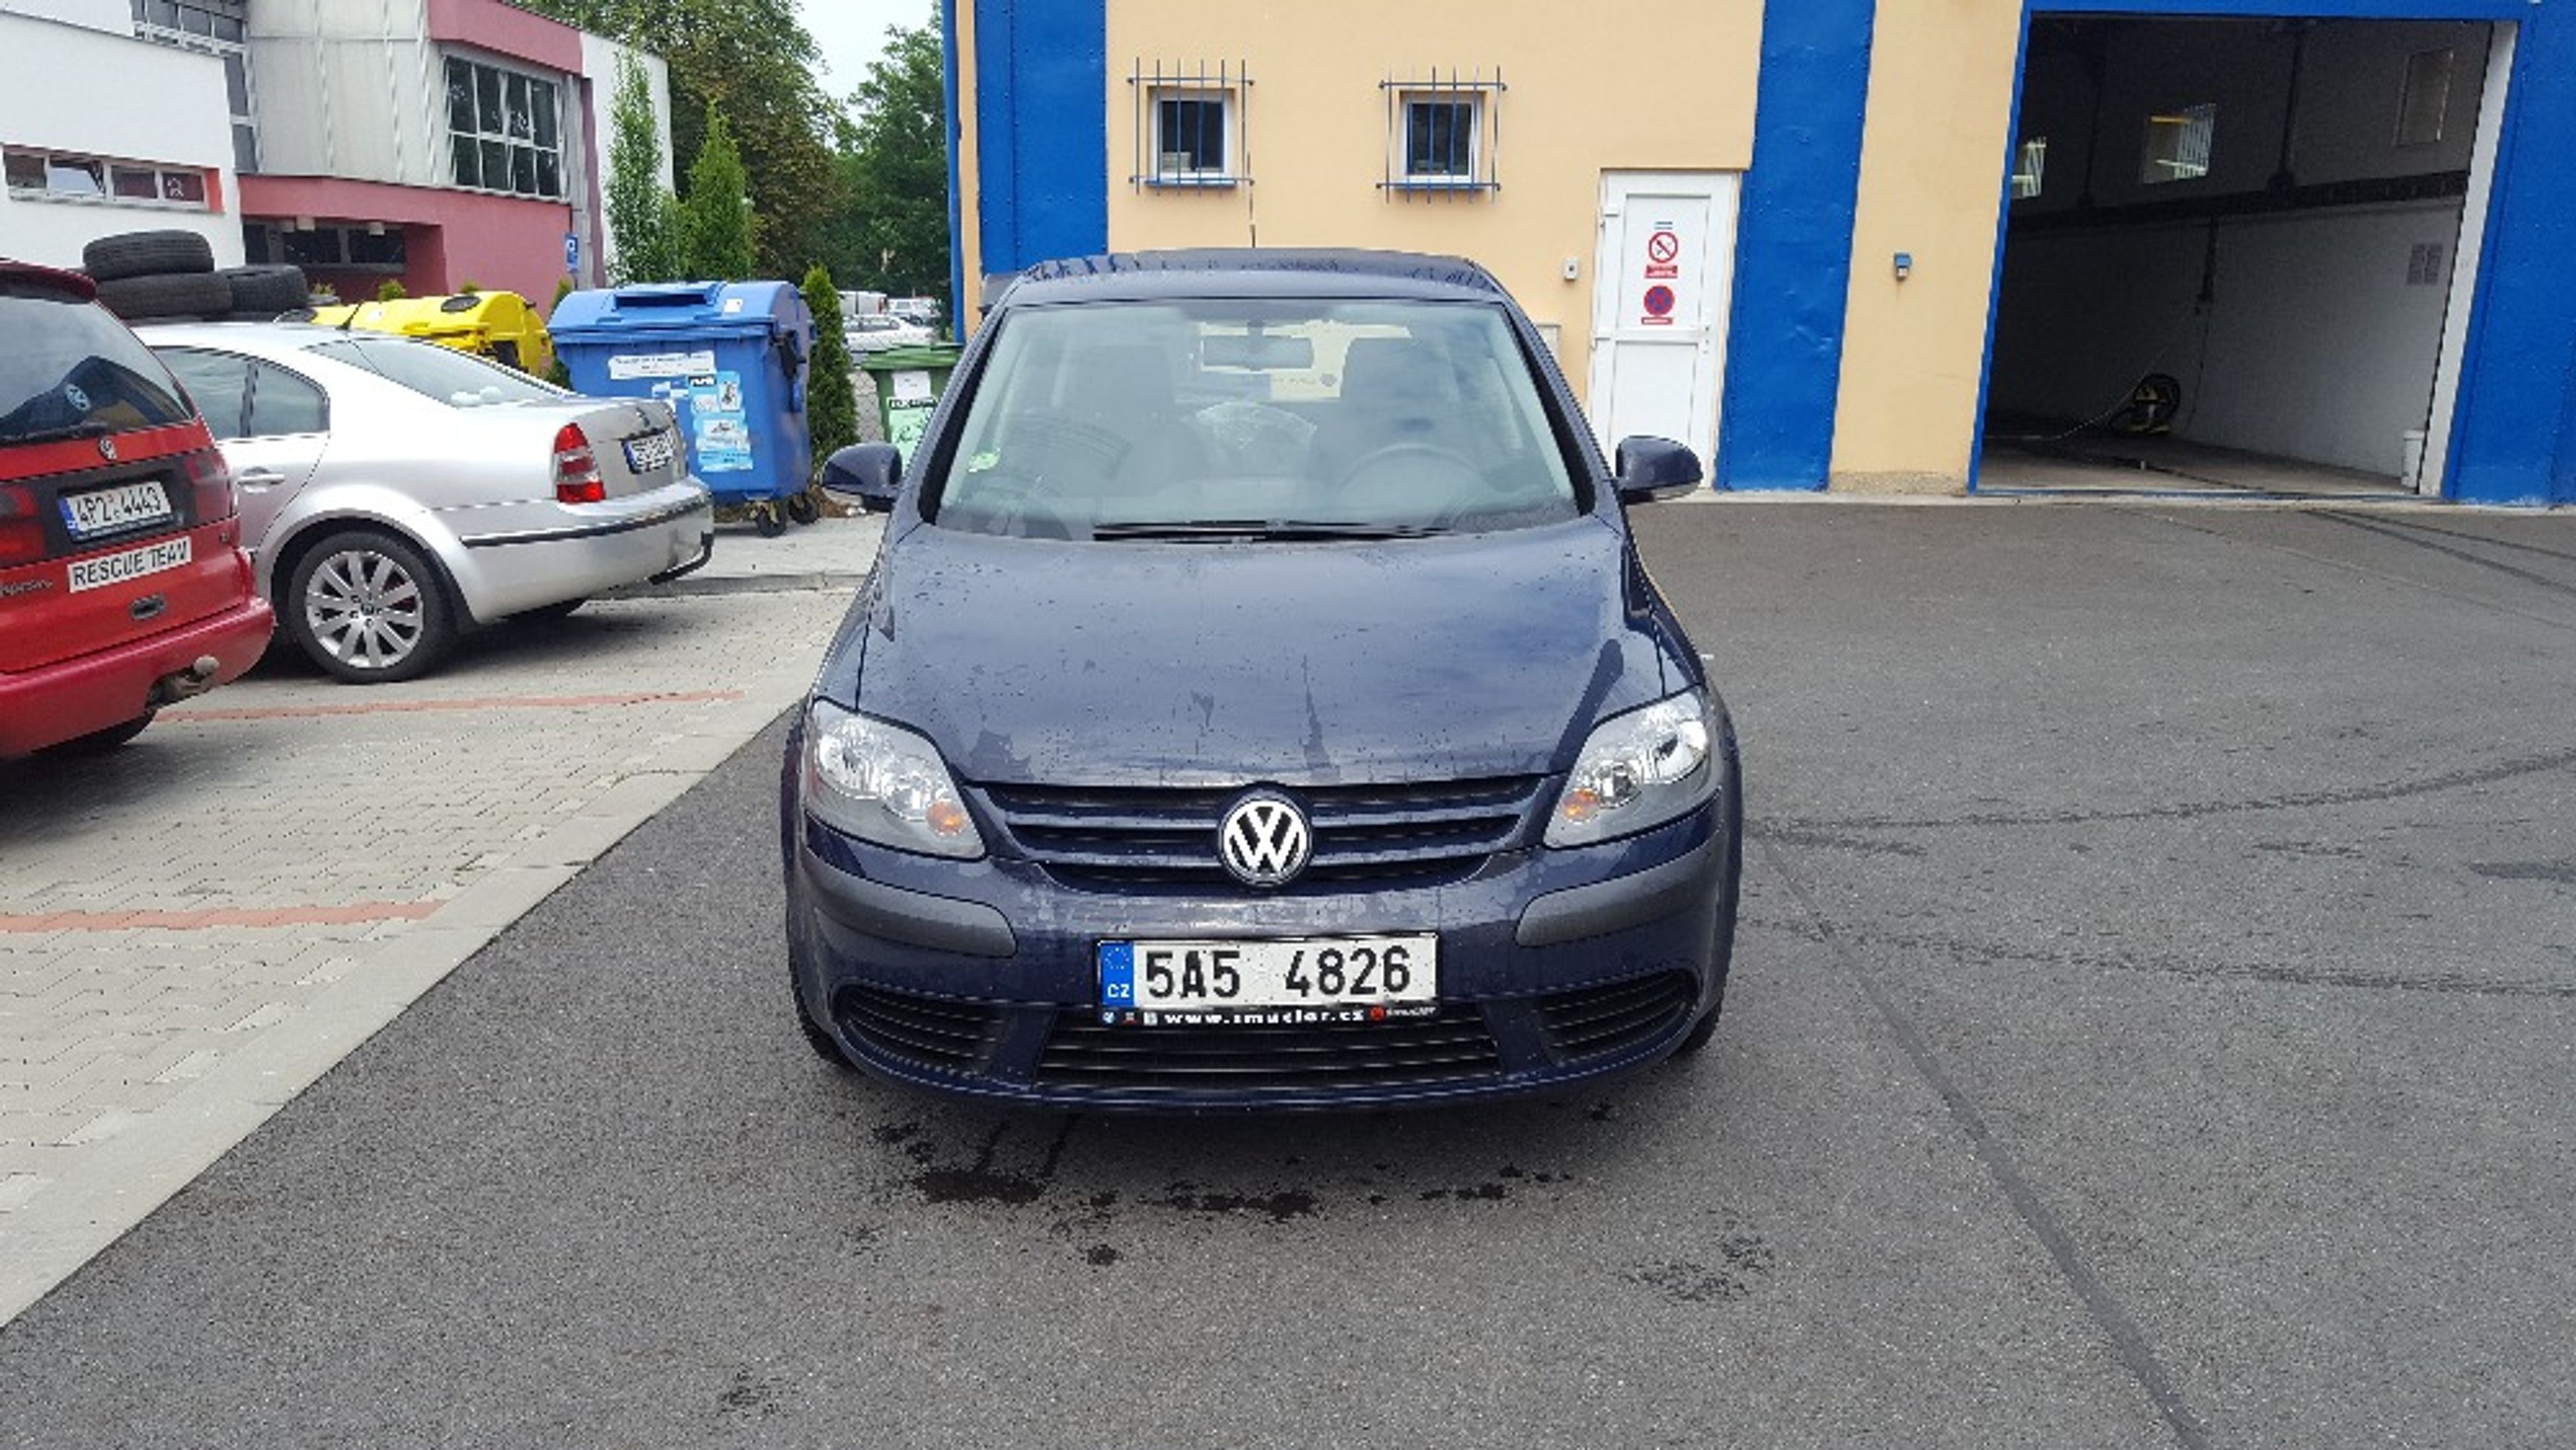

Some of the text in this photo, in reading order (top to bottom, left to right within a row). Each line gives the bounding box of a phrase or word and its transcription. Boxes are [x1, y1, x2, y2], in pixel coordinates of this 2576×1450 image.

[73, 541, 187, 586] RESCUE TEAM
[1107, 945, 1410, 998] CZ 5A5 4826
